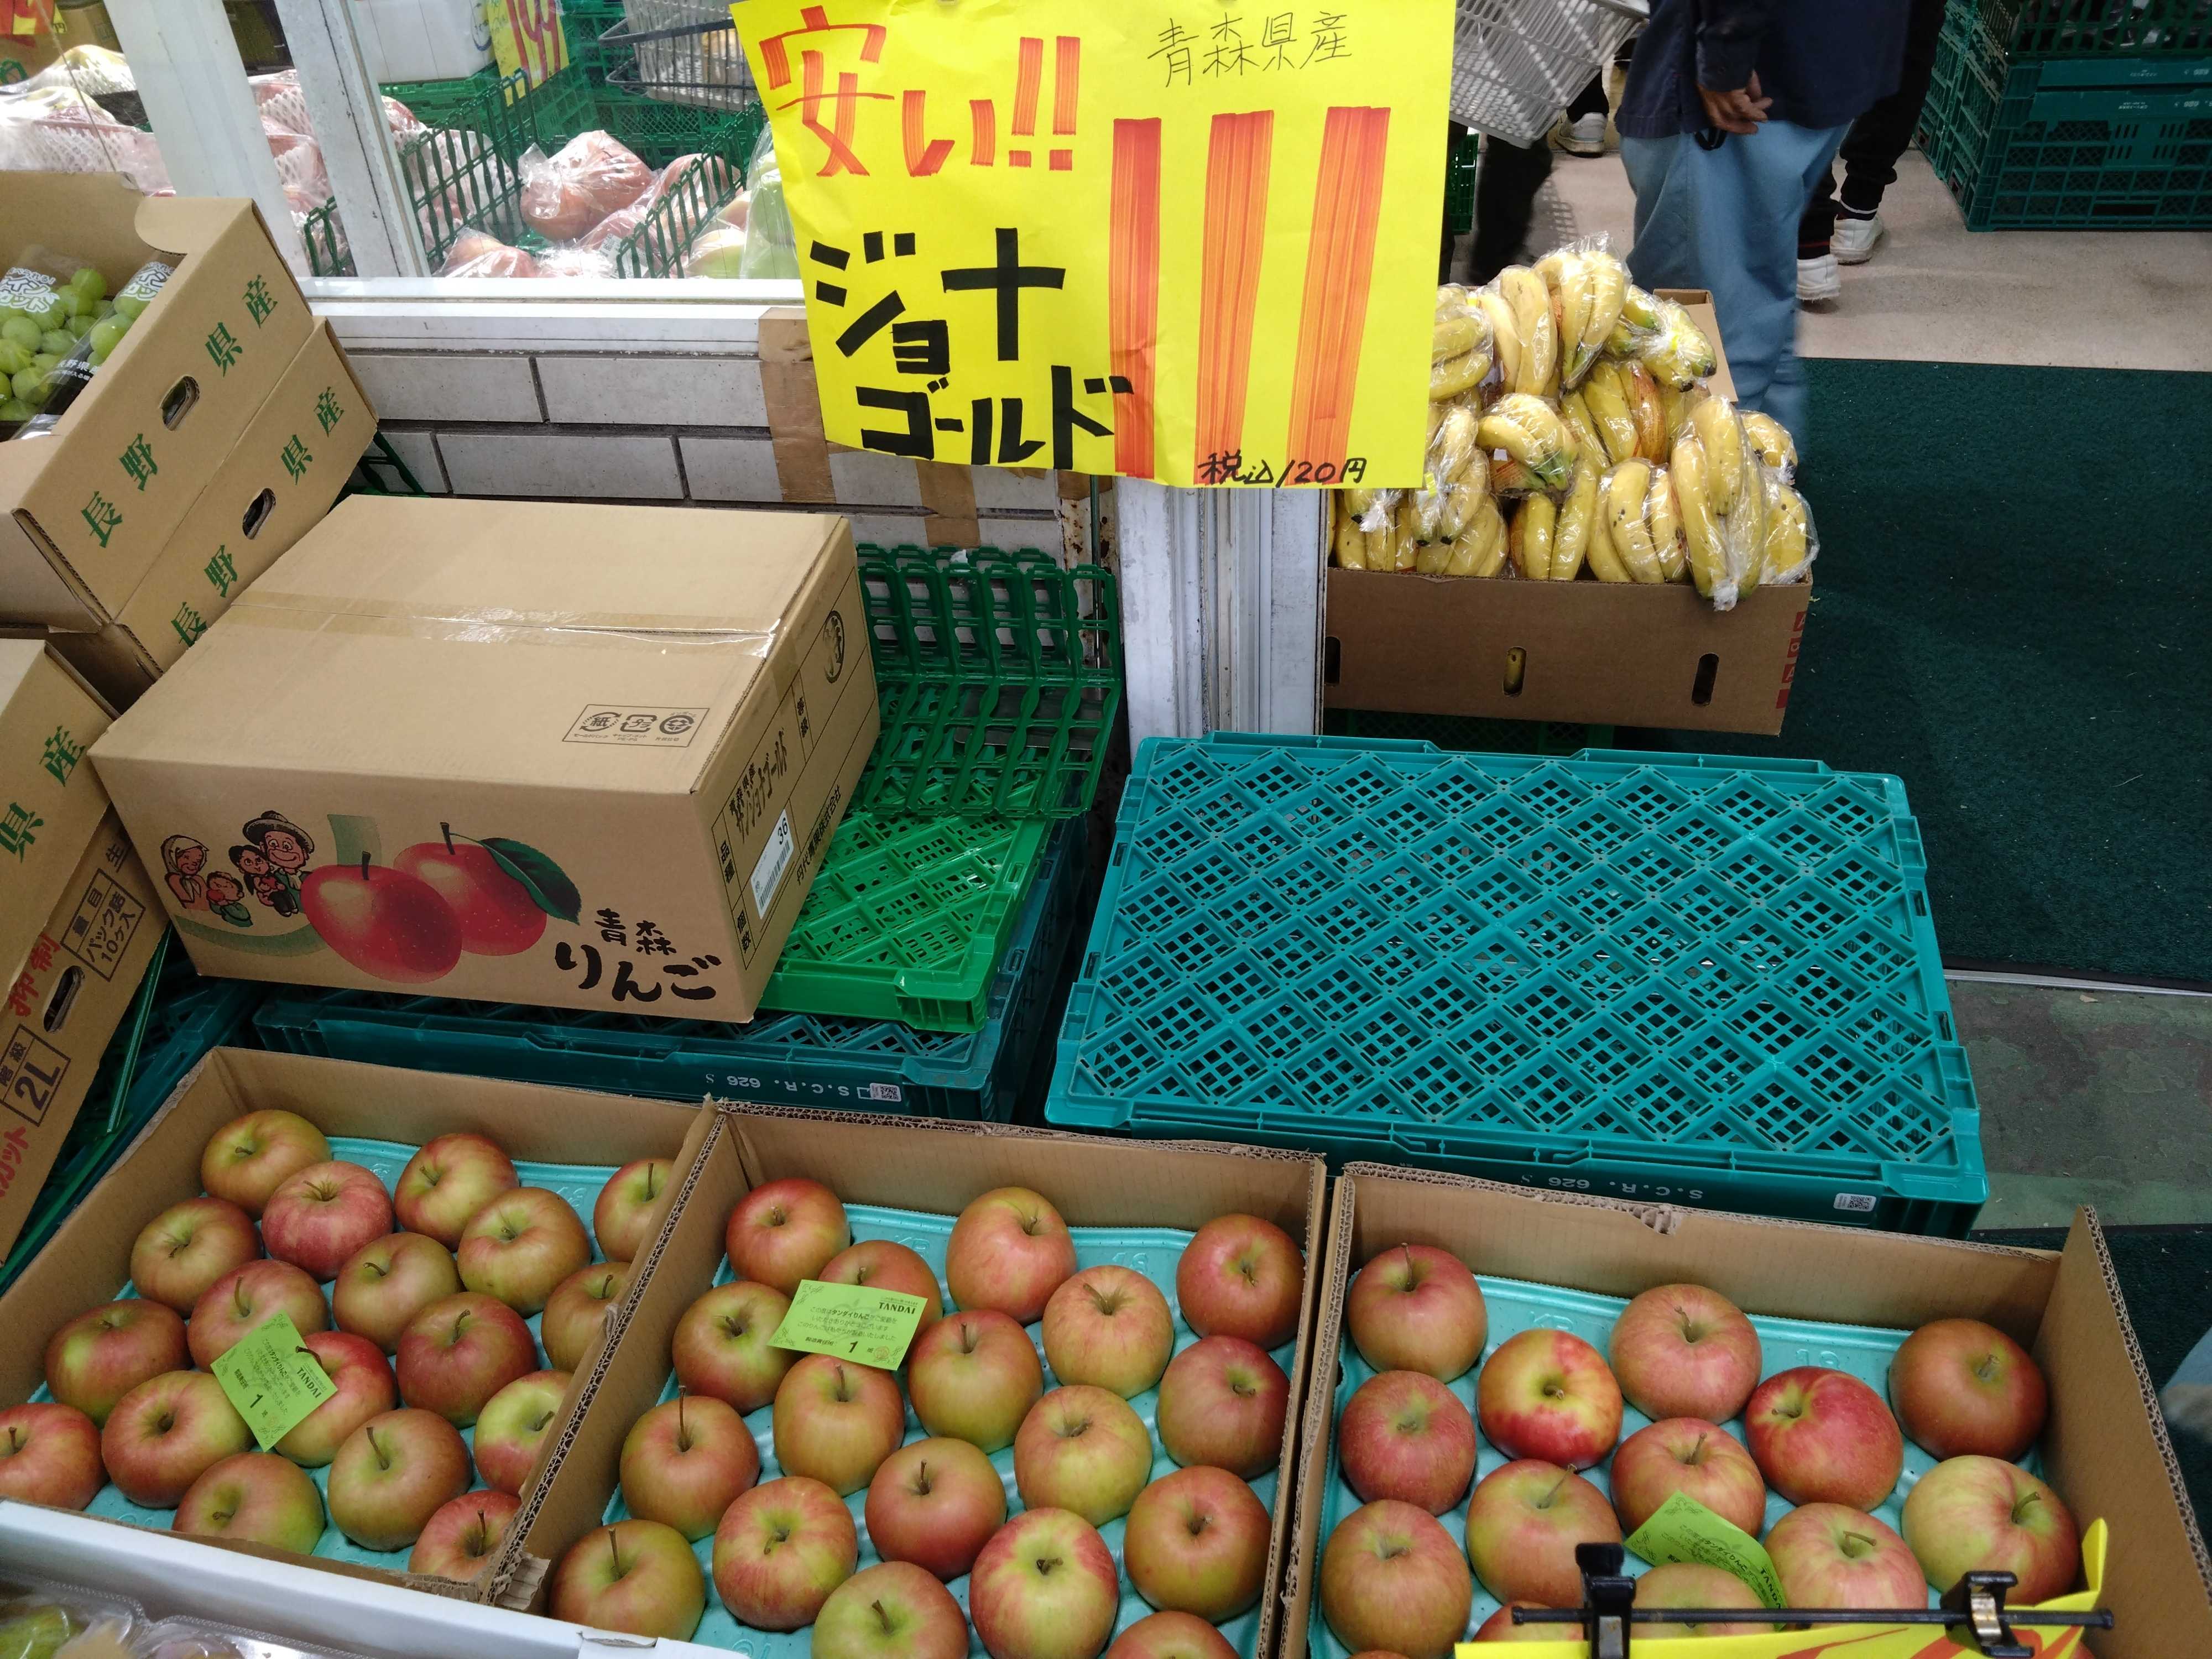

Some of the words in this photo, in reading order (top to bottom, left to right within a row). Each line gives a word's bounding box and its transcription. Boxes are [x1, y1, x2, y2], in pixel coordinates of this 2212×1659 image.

[1147, 11, 1352, 87] 青森県産
[810, 227, 1066, 375] ジョナ
[80, 275, 278, 548] 長野県産
[857, 364, 1134, 470] ゴールド
[171, 387, 345, 648] 長野県産
[589, 717, 610, 727] 紙
[629, 718, 653, 728] プラ
[0, 726, 85, 863] 県産
[777, 817, 789, 845] 36
[594, 908, 676, 955] 青森
[555, 942, 722, 1002] りんご
[14, 1061, 61, 1111] 2L
[726, 1075, 761, 1088] 626
[0, 1126, 29, 1198] カット
[1548, 1176, 1591, 1190] 626
[879, 1301, 916, 1314] TANDAI
[848, 1340, 859, 1353] 1
[249, 1393, 263, 1408] 1
[296, 1366, 322, 1399] TANDAI
[1760, 1566, 1782, 1610] TANDA
